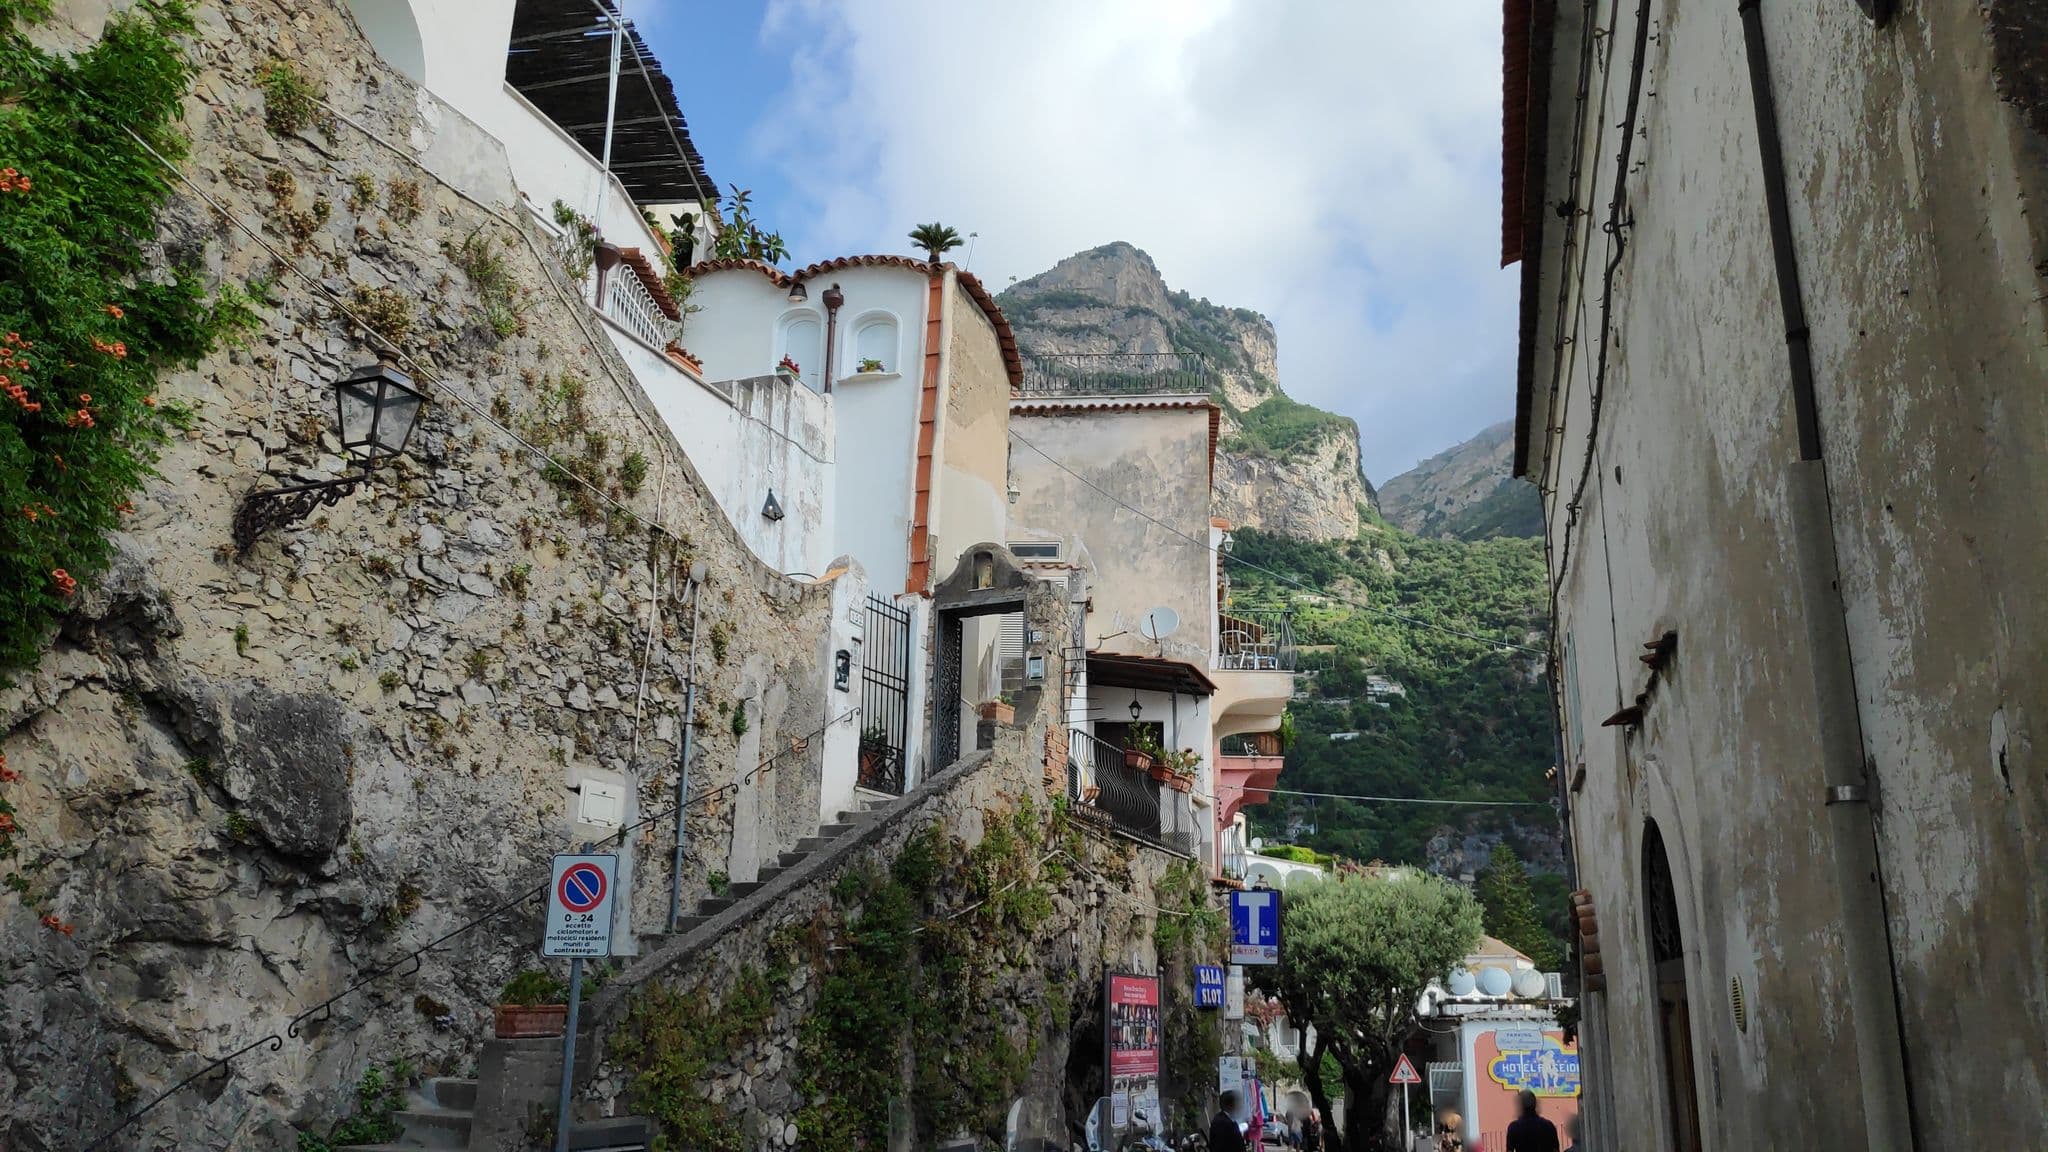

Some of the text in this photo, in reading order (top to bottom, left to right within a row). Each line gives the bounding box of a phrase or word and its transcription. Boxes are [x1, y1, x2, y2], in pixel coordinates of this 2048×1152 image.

[564, 914, 571, 922] 0
[581, 914, 593, 922] 24
[1238, 892, 1270, 944] T
[1200, 968, 1221, 984] SALA
[1202, 988, 1221, 1003] SLOT
[1502, 1063, 1536, 1072] HOTEL
